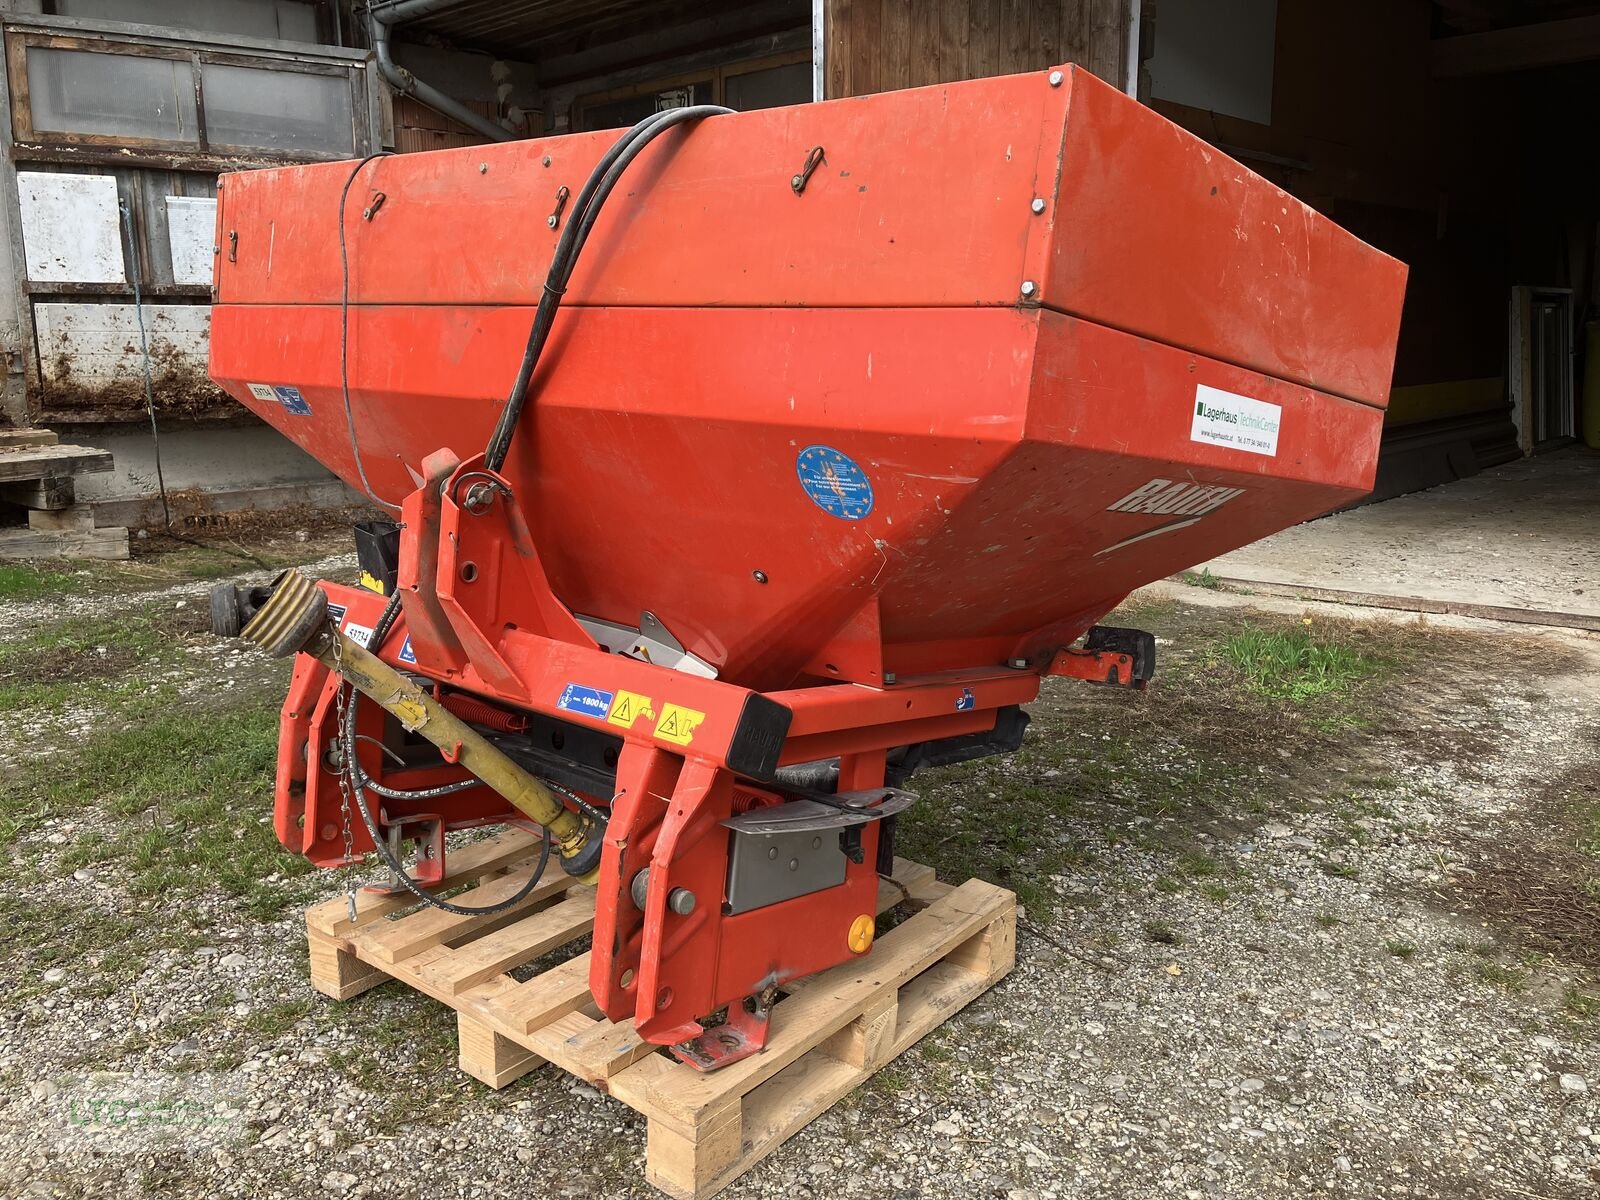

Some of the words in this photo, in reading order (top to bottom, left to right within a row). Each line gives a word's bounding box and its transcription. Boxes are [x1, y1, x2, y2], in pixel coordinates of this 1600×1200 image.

[1203, 404, 1238, 424] Lagerhaus
[1240, 412, 1278, 433] TechnikCenter
[1106, 478, 1247, 515] RAUCH
[349, 628, 370, 643] 53734
[582, 696, 600, 707] 1800
[599, 700, 608, 711] kg
